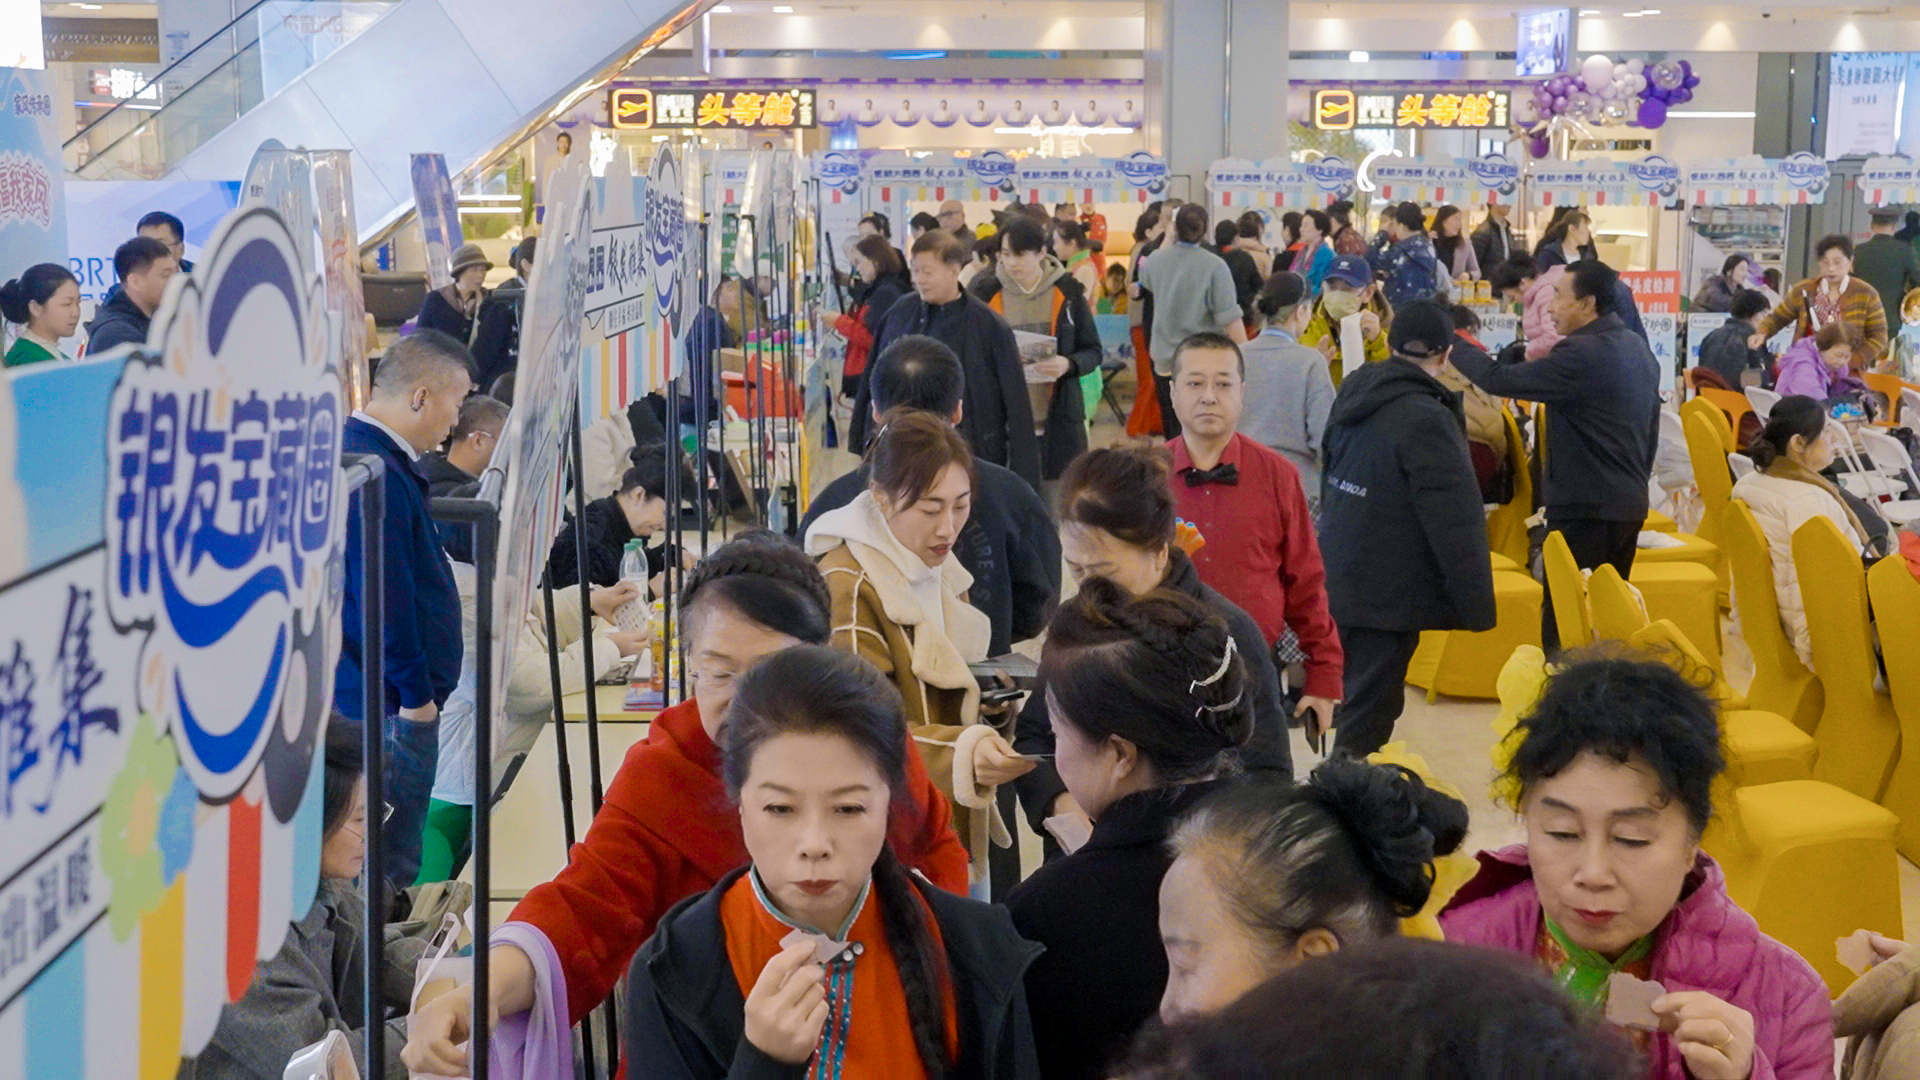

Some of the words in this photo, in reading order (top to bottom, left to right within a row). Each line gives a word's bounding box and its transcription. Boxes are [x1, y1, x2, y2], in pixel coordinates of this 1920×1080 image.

[697, 92, 797, 126] 头等舱
[1397, 93, 1492, 127] 头等舱
[645, 187, 684, 256] 银发宝藏圈
[116, 387, 337, 600] 银发宝藏圈
